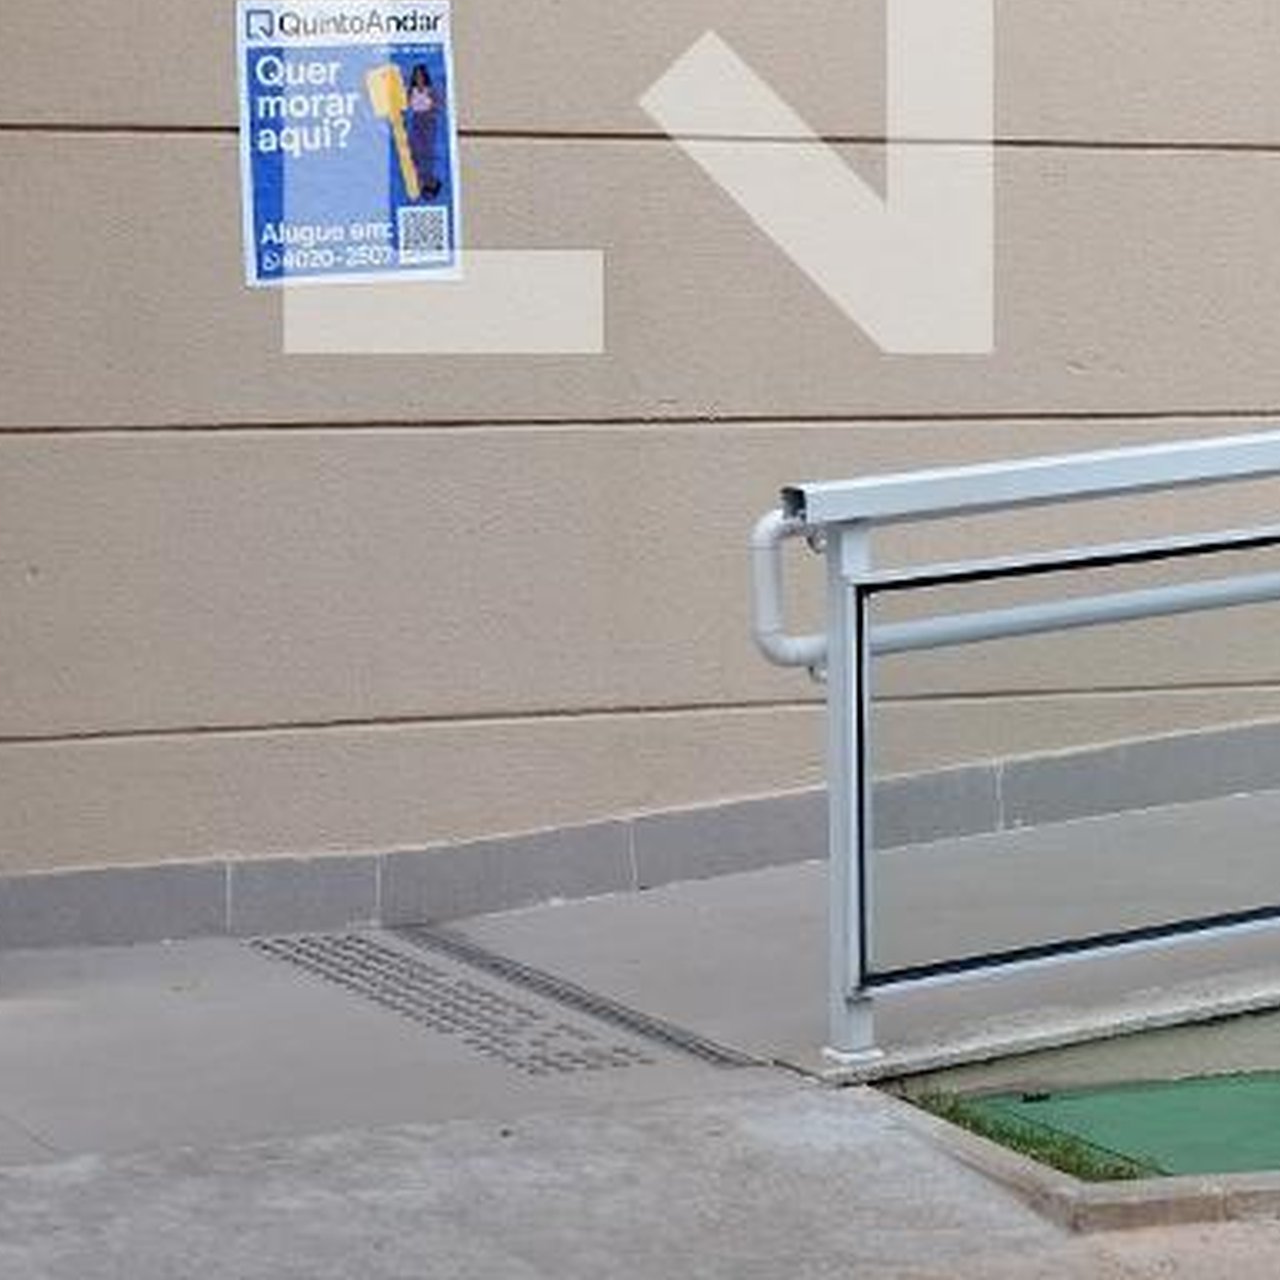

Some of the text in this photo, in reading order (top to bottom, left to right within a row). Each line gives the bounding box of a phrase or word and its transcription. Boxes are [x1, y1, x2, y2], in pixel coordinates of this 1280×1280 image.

[278, 9, 441, 35] QuintoAndar
[256, 55, 340, 86] Quer
[258, 91, 358, 118] morar
[258, 120, 351, 157] aqui?
[261, 222, 345, 247] Alugue
